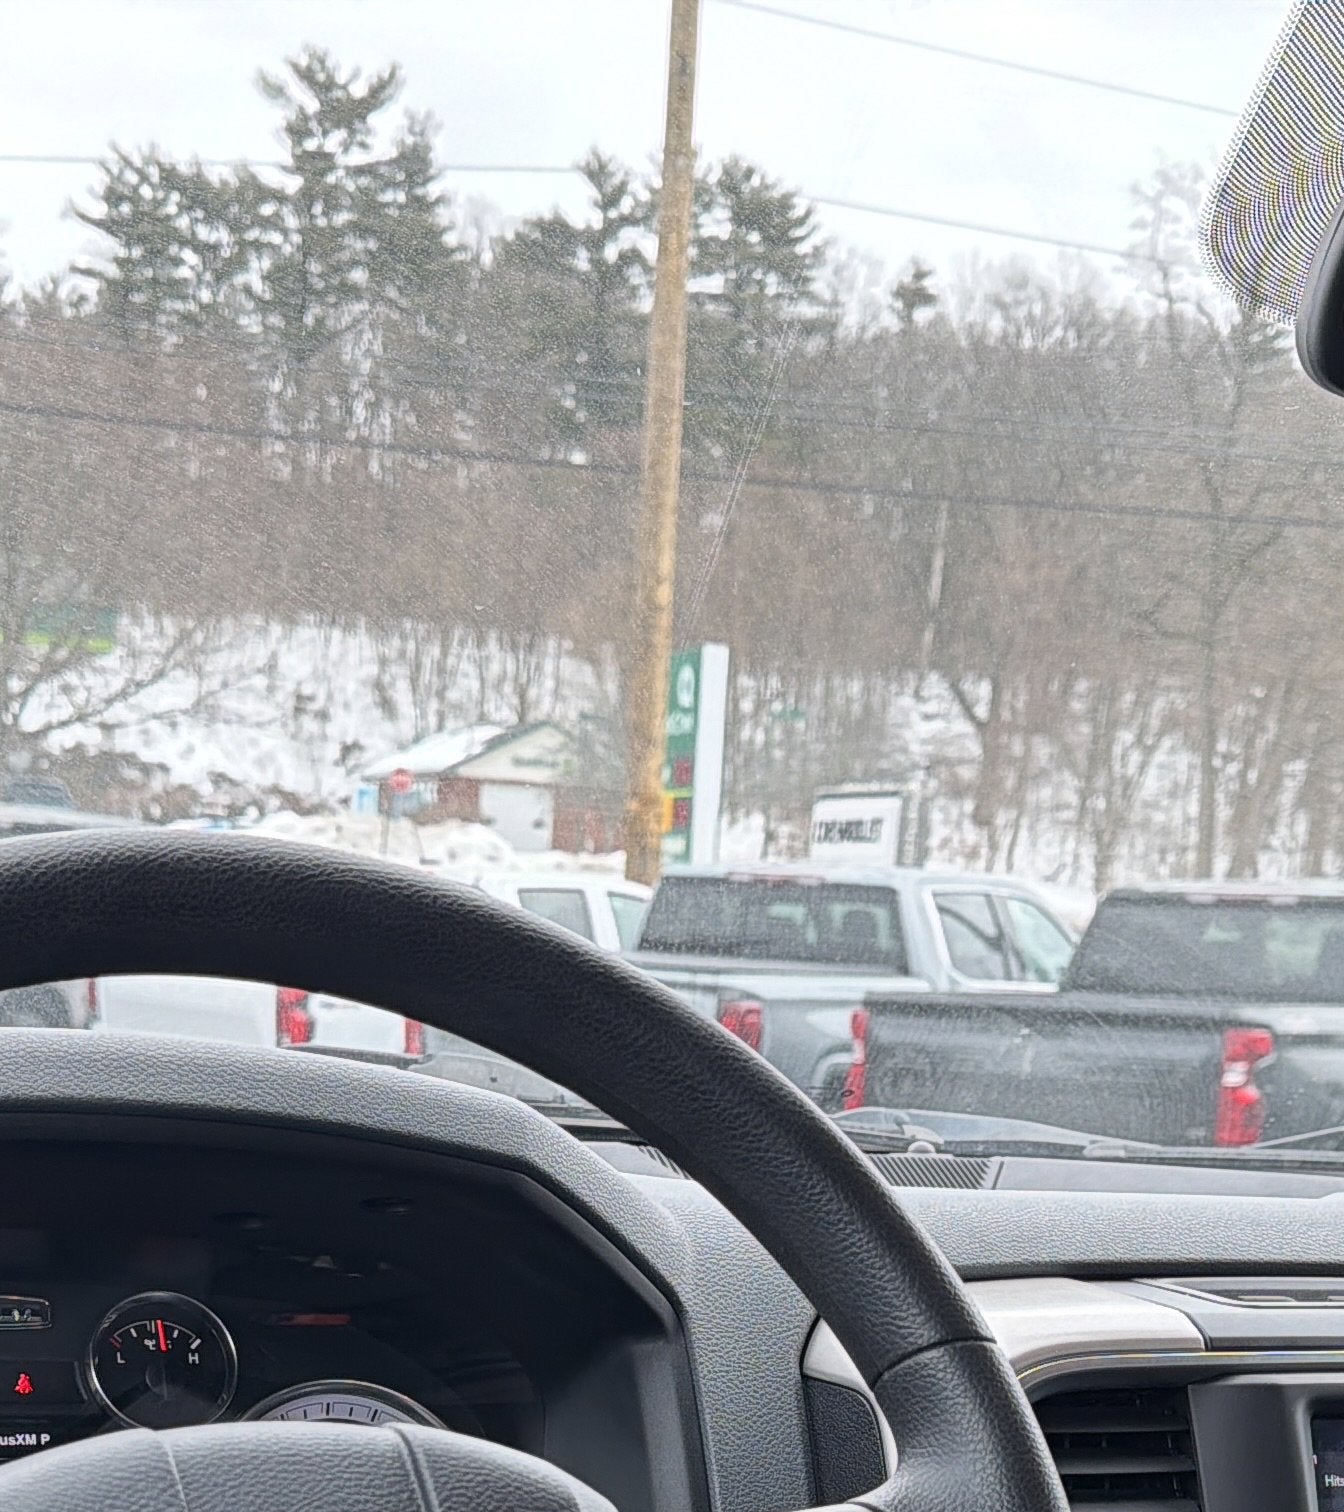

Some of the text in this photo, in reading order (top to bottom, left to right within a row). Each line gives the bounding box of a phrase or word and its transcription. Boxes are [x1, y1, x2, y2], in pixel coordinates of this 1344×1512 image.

[116, 1351, 126, 1364] L
[188, 1352, 200, 1364] H
[41, 1433, 51, 1446] P
